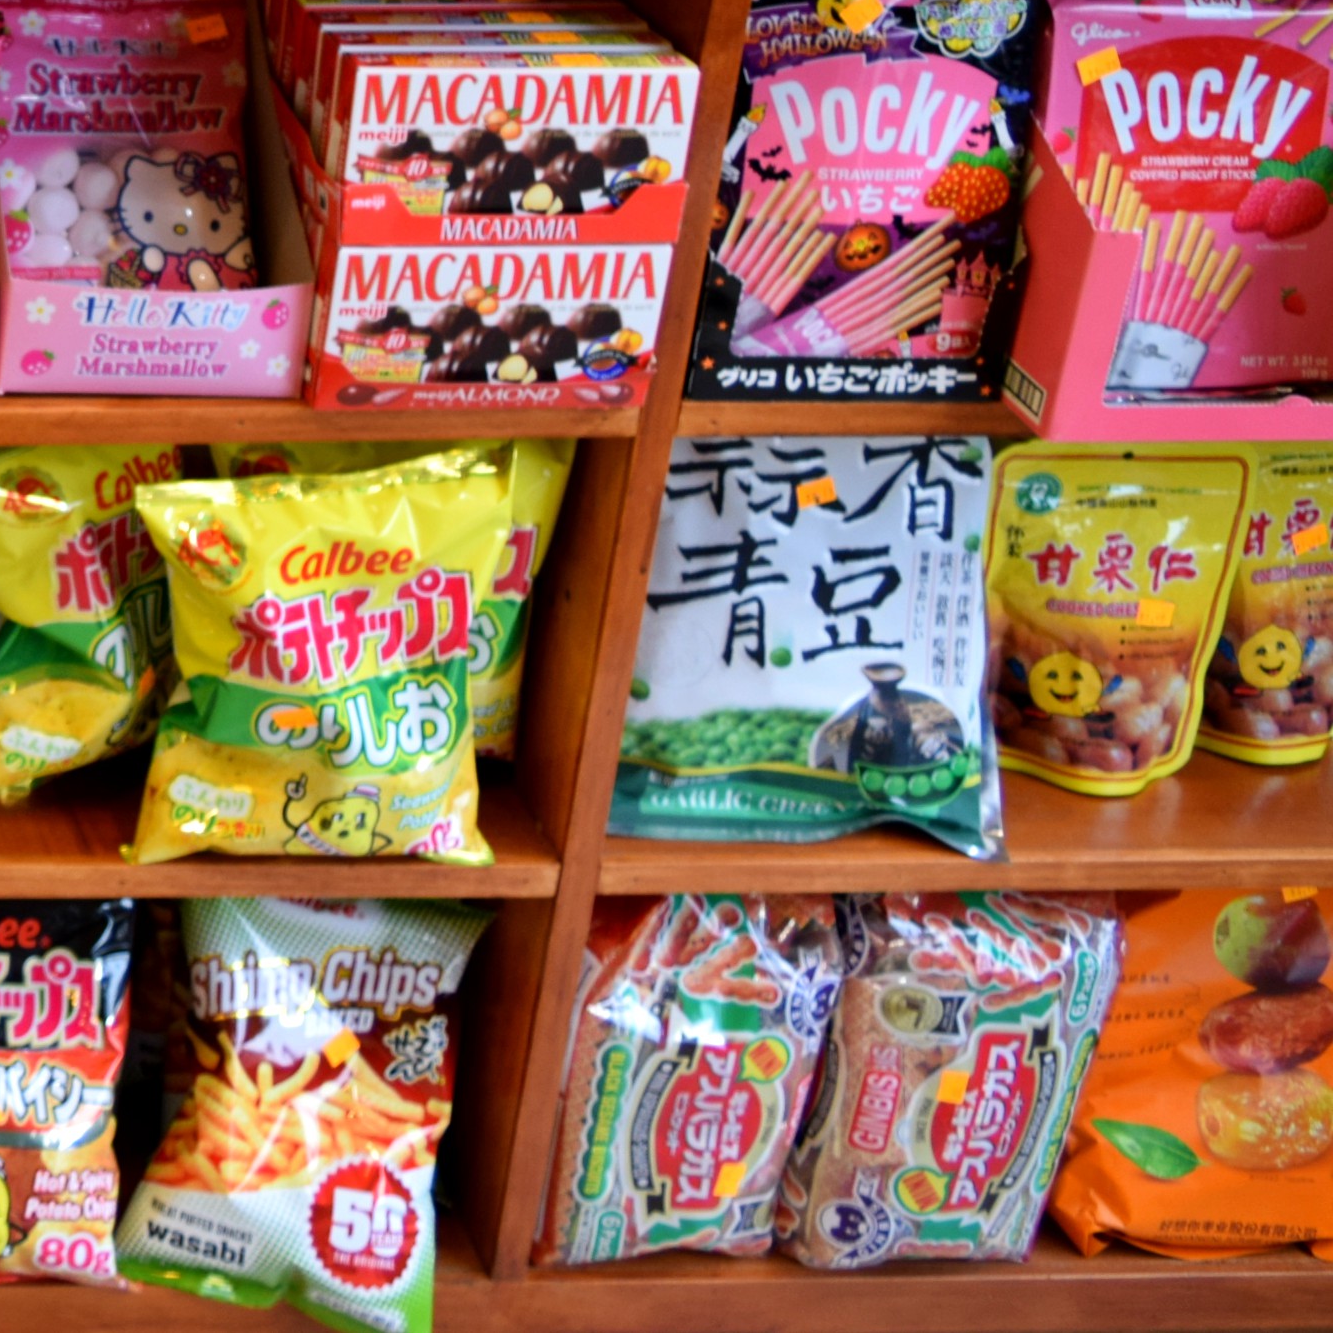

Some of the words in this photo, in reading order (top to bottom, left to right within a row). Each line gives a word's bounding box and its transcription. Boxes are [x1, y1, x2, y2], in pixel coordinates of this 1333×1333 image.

[29, 65, 201, 99] Strawberry
[361, 73, 685, 126] MACADAMIA
[13, 104, 225, 135] Marshmallow
[770, 73, 982, 169] Pocky
[818, 168, 925, 183] STRAWBERRY
[1141, 156, 1209, 169] STRAWBERRY
[1213, 155, 1249, 168] CREAM
[821, 186, 919, 213] いちご
[440, 218, 578, 242] MACADAMIA
[341, 252, 657, 302] MACADAMIA
[76, 296, 162, 327] Hello
[169, 300, 249, 328] Kitty
[785, 365, 978, 393] いちごポッキー
[279, 542, 414, 586] Calbee
[1027, 533, 1198, 594] 甘栗仁
[647, 530, 903, 668] 青豆
[230, 569, 472, 685] ポテトチップス
[323, 949, 440, 1015] Chips
[851, 1070, 901, 1150] GIMBIS
[36, 1234, 112, 1276] 80g
[146, 1217, 246, 1266] wasabi
